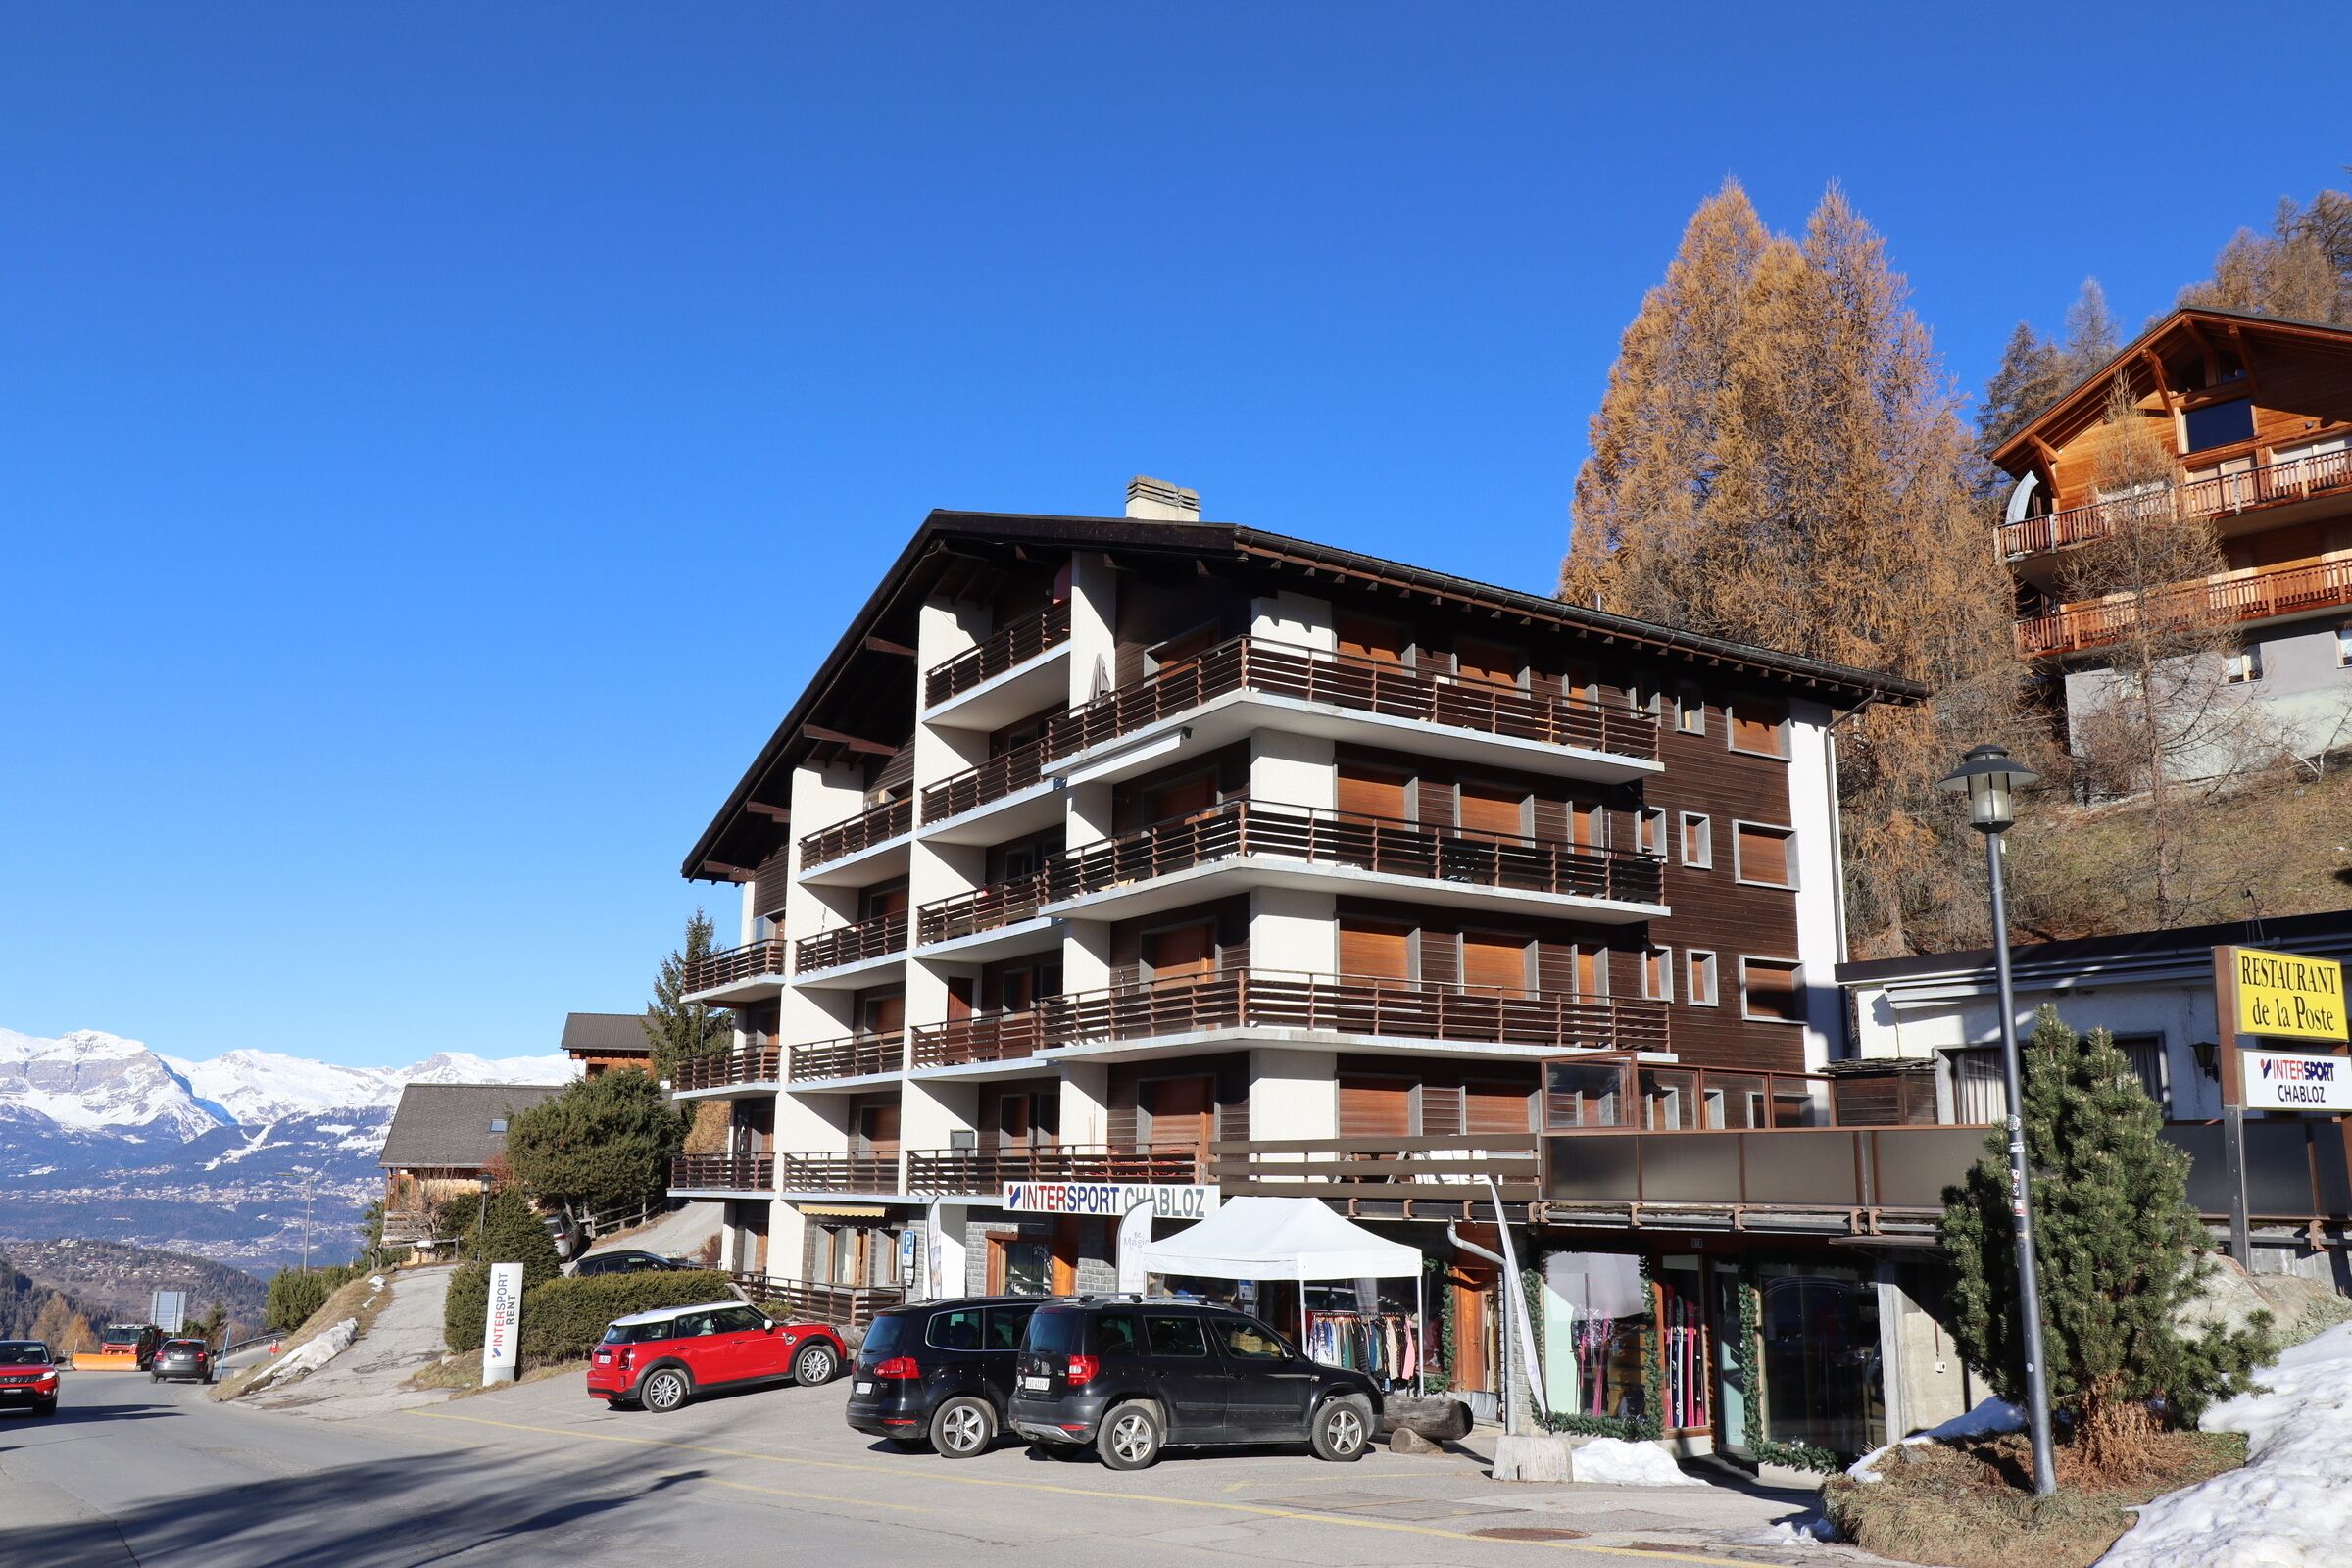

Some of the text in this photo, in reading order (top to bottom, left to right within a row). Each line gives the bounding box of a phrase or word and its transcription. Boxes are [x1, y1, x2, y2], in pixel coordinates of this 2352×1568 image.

[2241, 956, 2336, 995] RESTAURANT
[2252, 995, 2335, 1031] de la Poste
[2272, 1059, 2334, 1082] INTERSPORT
[2278, 1084, 2327, 1103] CHABLOZ
[1022, 1184, 1120, 1214] INTERSPORT
[906, 1234, 911, 1250] P
[492, 1272, 509, 1347] INTERSPORT
[506, 1295, 515, 1325] RENT
